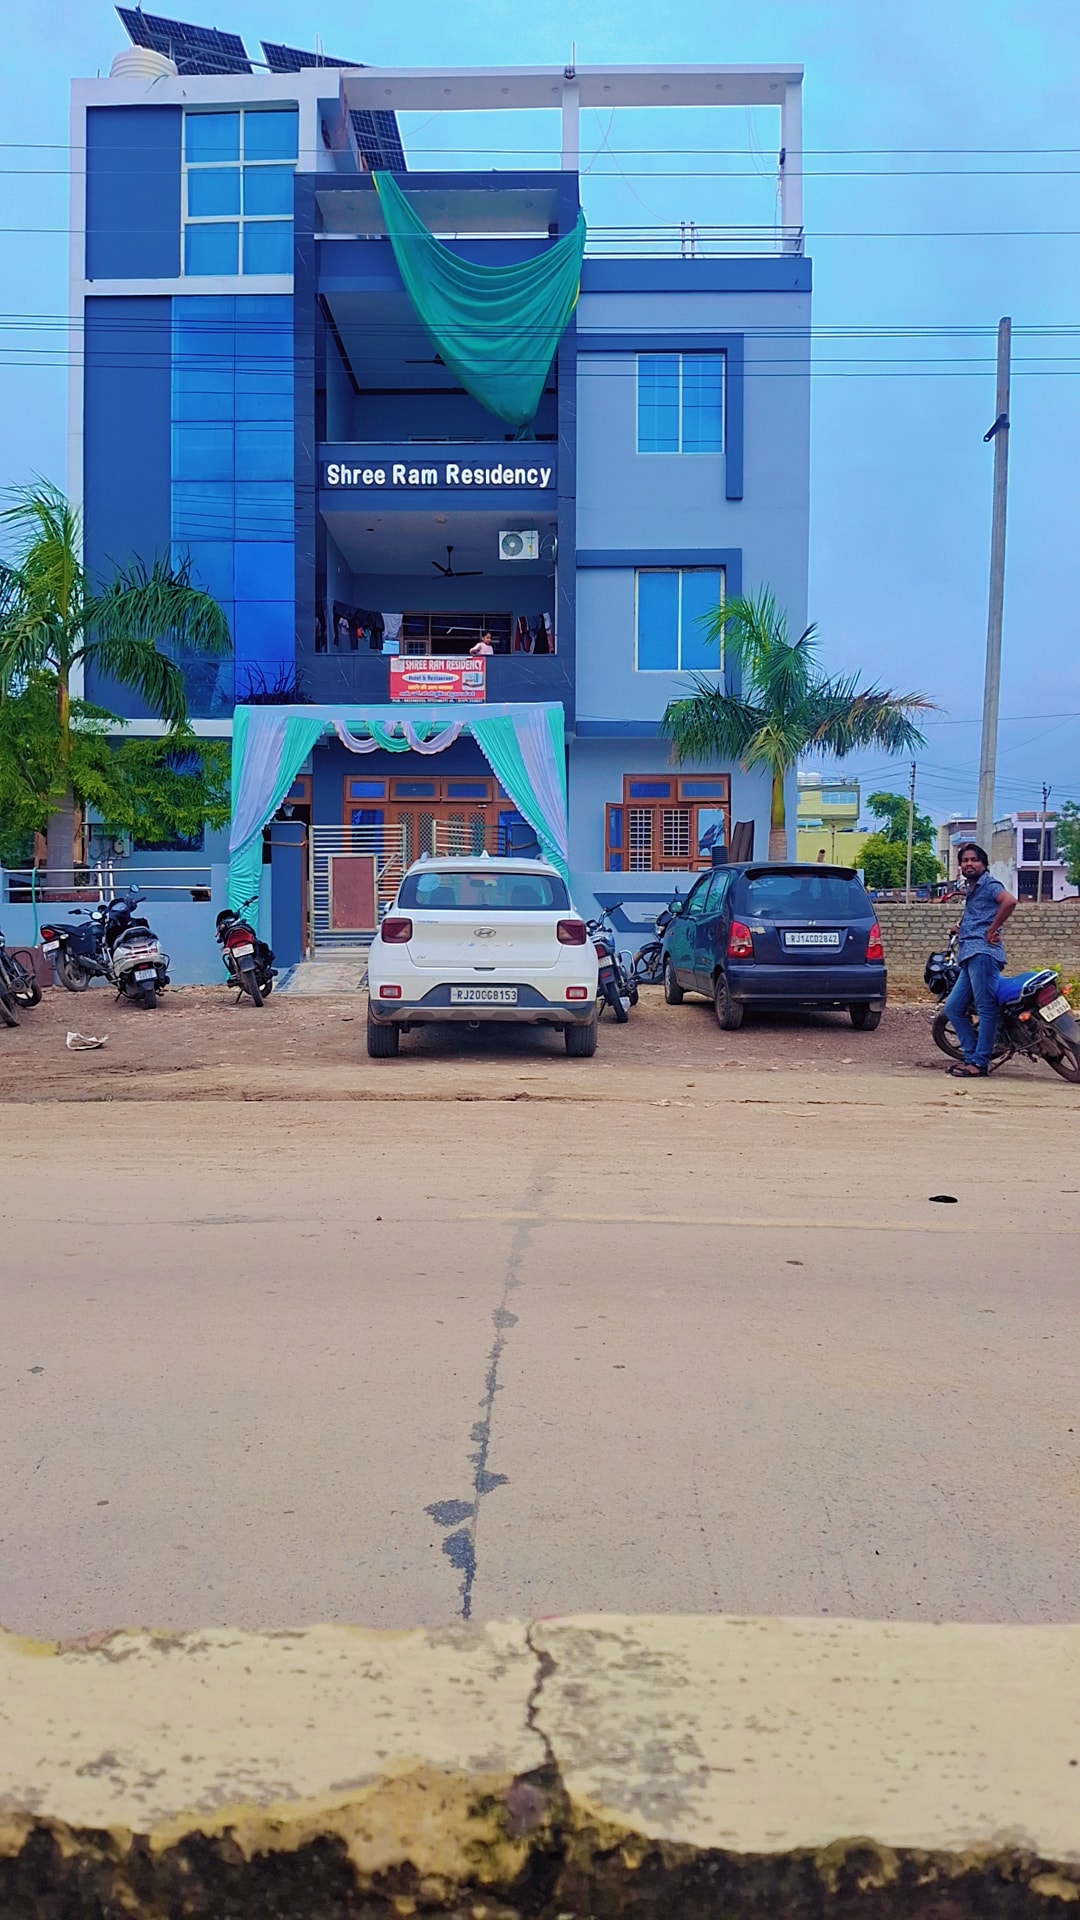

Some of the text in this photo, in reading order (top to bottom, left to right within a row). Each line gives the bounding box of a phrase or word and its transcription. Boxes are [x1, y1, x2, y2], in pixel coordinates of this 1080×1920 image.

[327, 464, 551, 488] Shree Ram Residency
[406, 660, 483, 671] SHREE RAM RESIDENCY
[791, 935, 837, 943] RJ14CD2842
[457, 990, 517, 1000] RJ20CG8153
